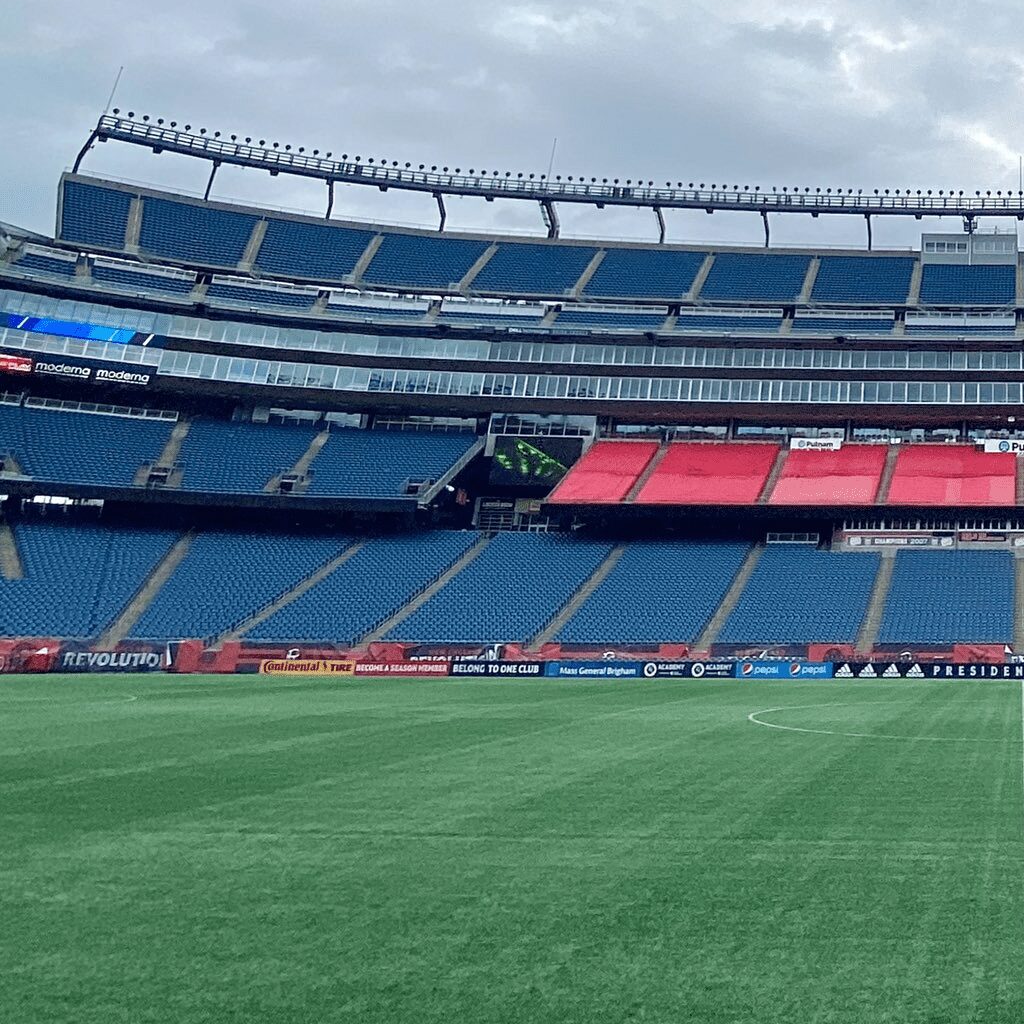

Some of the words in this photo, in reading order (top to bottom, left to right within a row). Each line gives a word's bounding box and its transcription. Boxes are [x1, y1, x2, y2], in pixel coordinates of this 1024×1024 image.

[36, 362, 91, 376] moderna
[96, 369, 150, 382] moderna
[263, 660, 320, 673] Continental
[330, 664, 352, 672] TIRE
[452, 664, 485, 673] BELONG
[488, 664, 499, 673] TO
[500, 664, 517, 673] ONE
[518, 664, 539, 673] CLUB
[754, 665, 779, 674] pepsi
[801, 665, 826, 674] pepsi
[559, 667, 578, 675] Mass
[579, 667, 606, 675] General
[607, 667, 636, 677] Brigham
